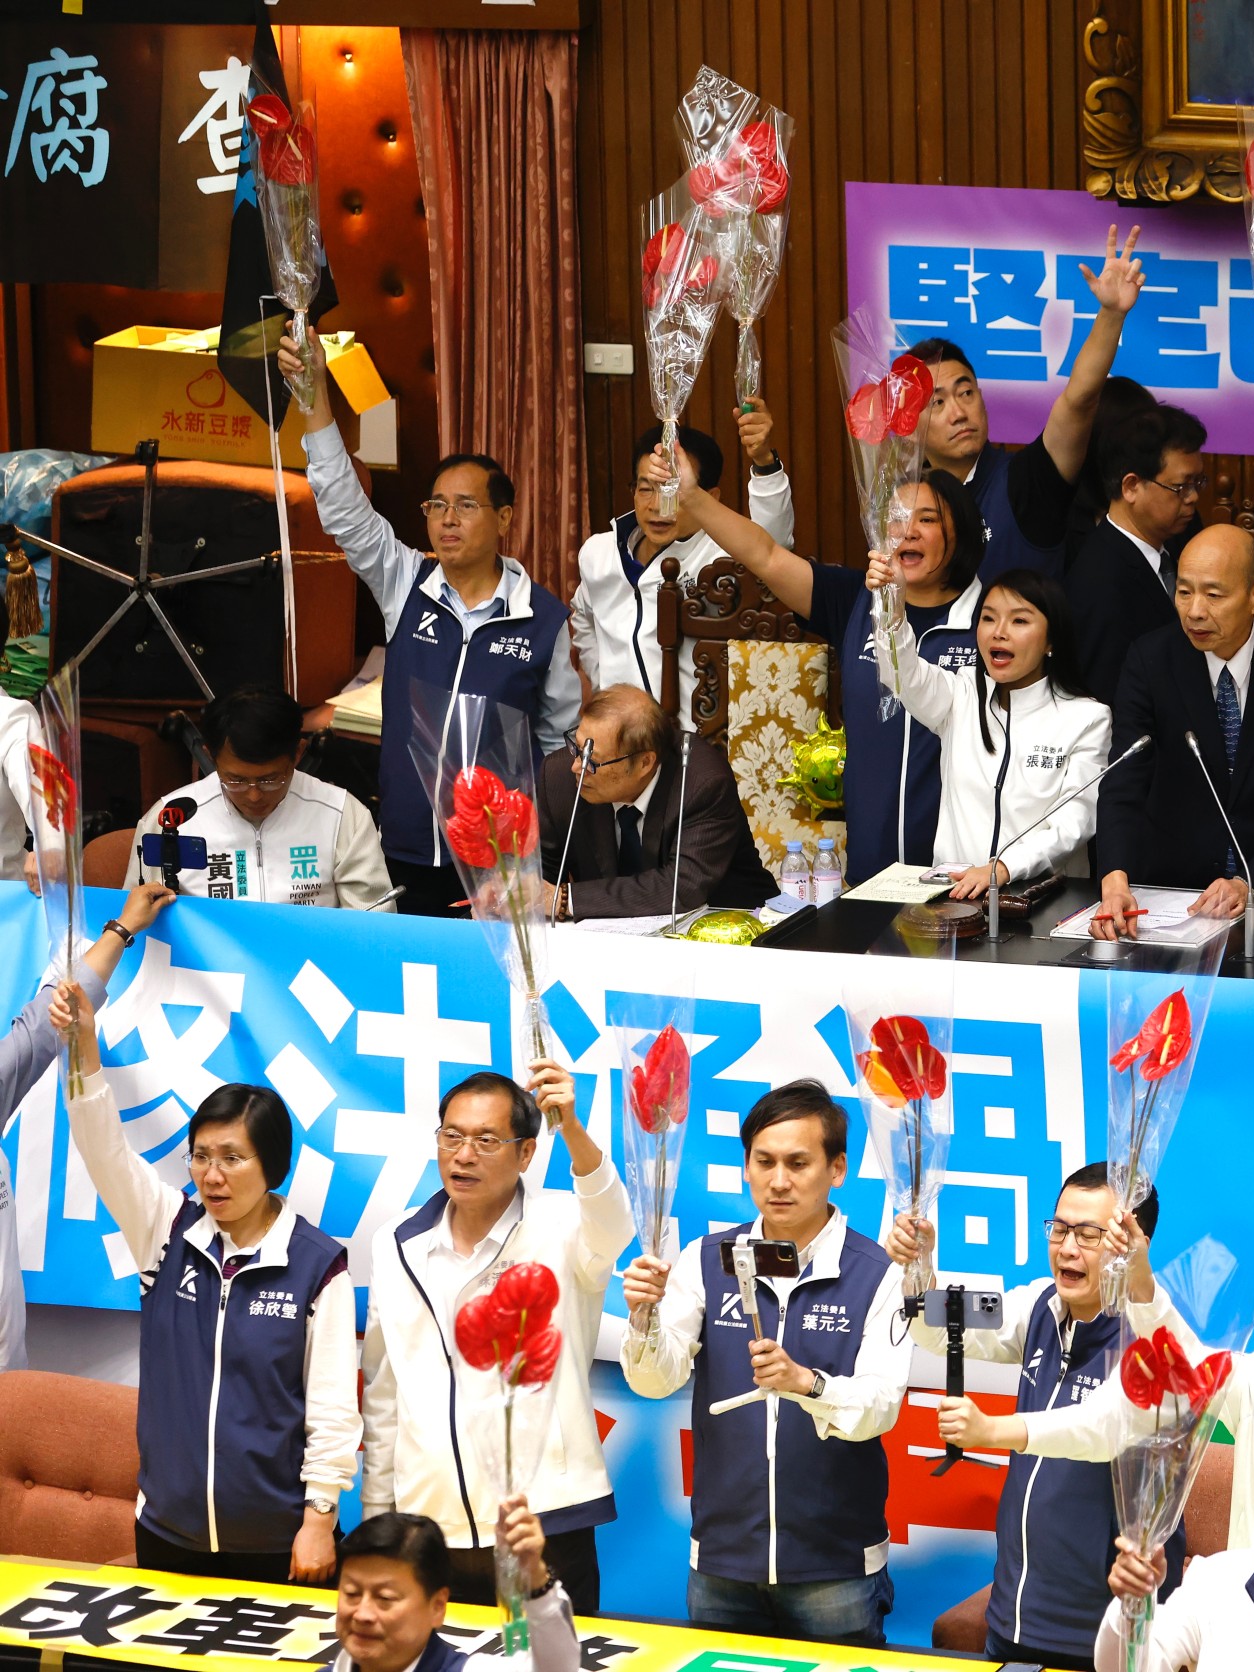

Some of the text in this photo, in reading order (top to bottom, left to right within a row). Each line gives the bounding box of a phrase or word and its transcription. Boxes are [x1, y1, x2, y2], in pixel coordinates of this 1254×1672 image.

[4, 47, 110, 188] 腐
[161, 408, 252, 438] 永新豆漿
[488, 642, 533, 662] 鄭天財
[236, 851, 248, 897] 立法委員
[292, 882, 322, 891] TAIWAN
[258, 1290, 294, 1302] 立法委員
[248, 1300, 298, 1320] 徐欣瑩
[811, 1303, 847, 1315] 立法委員
[801, 1313, 851, 1333] 葉元之
